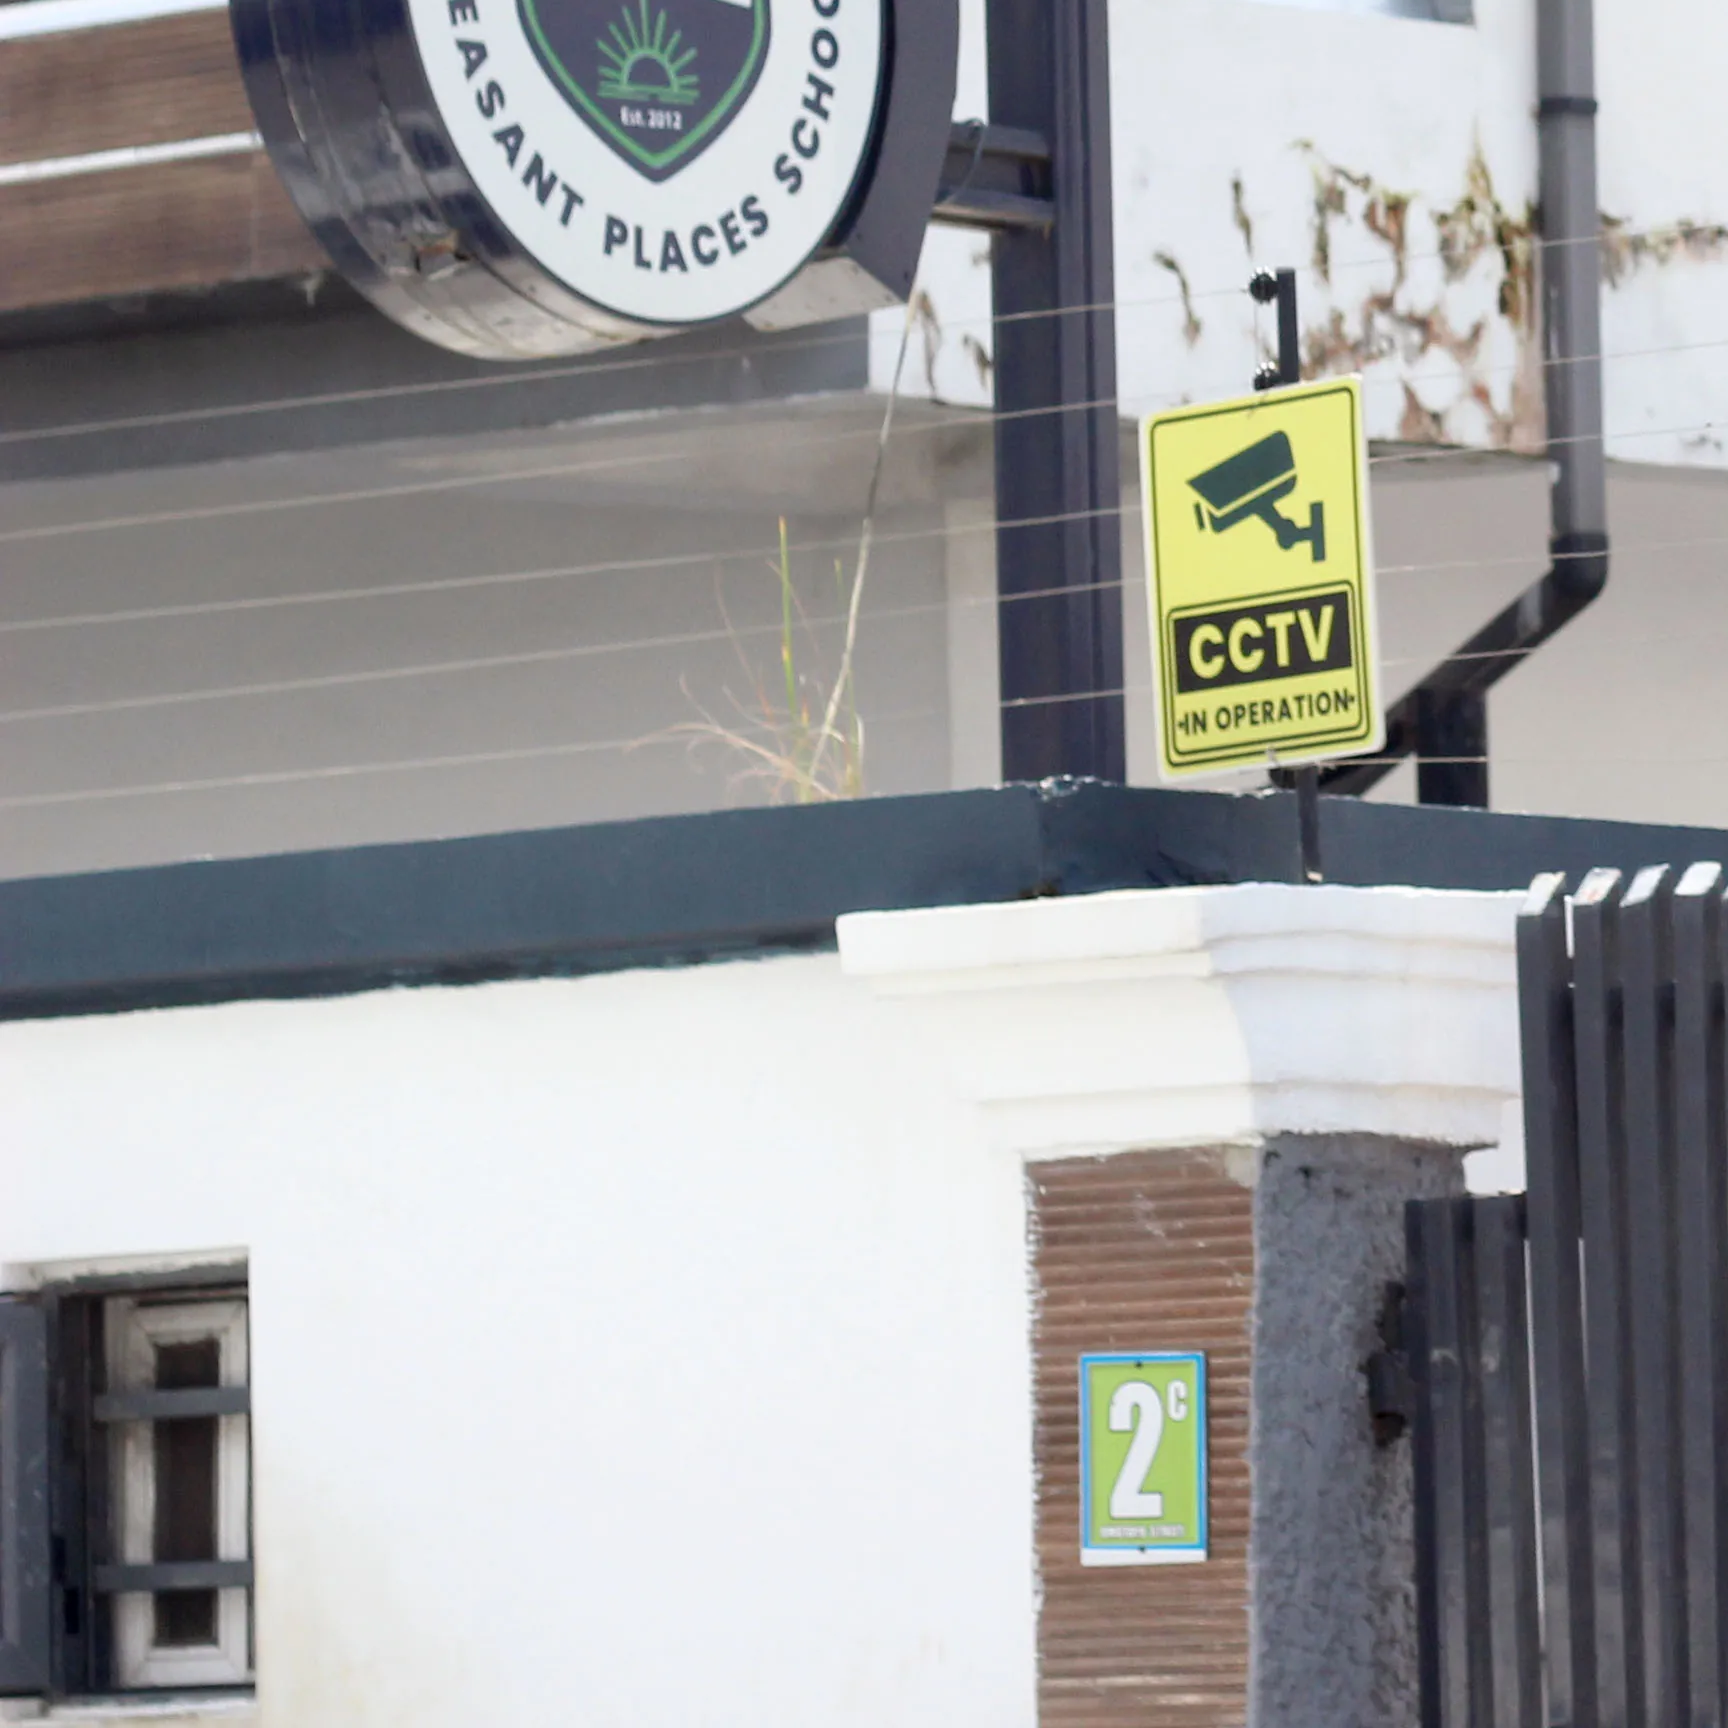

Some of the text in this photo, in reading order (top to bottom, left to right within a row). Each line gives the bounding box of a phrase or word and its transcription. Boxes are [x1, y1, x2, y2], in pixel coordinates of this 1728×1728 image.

[646, 108, 682, 130] 2012
[603, 194, 771, 274] PLACES
[1188, 604, 1335, 680] CCTV
[1215, 687, 1350, 732] OPERATION
